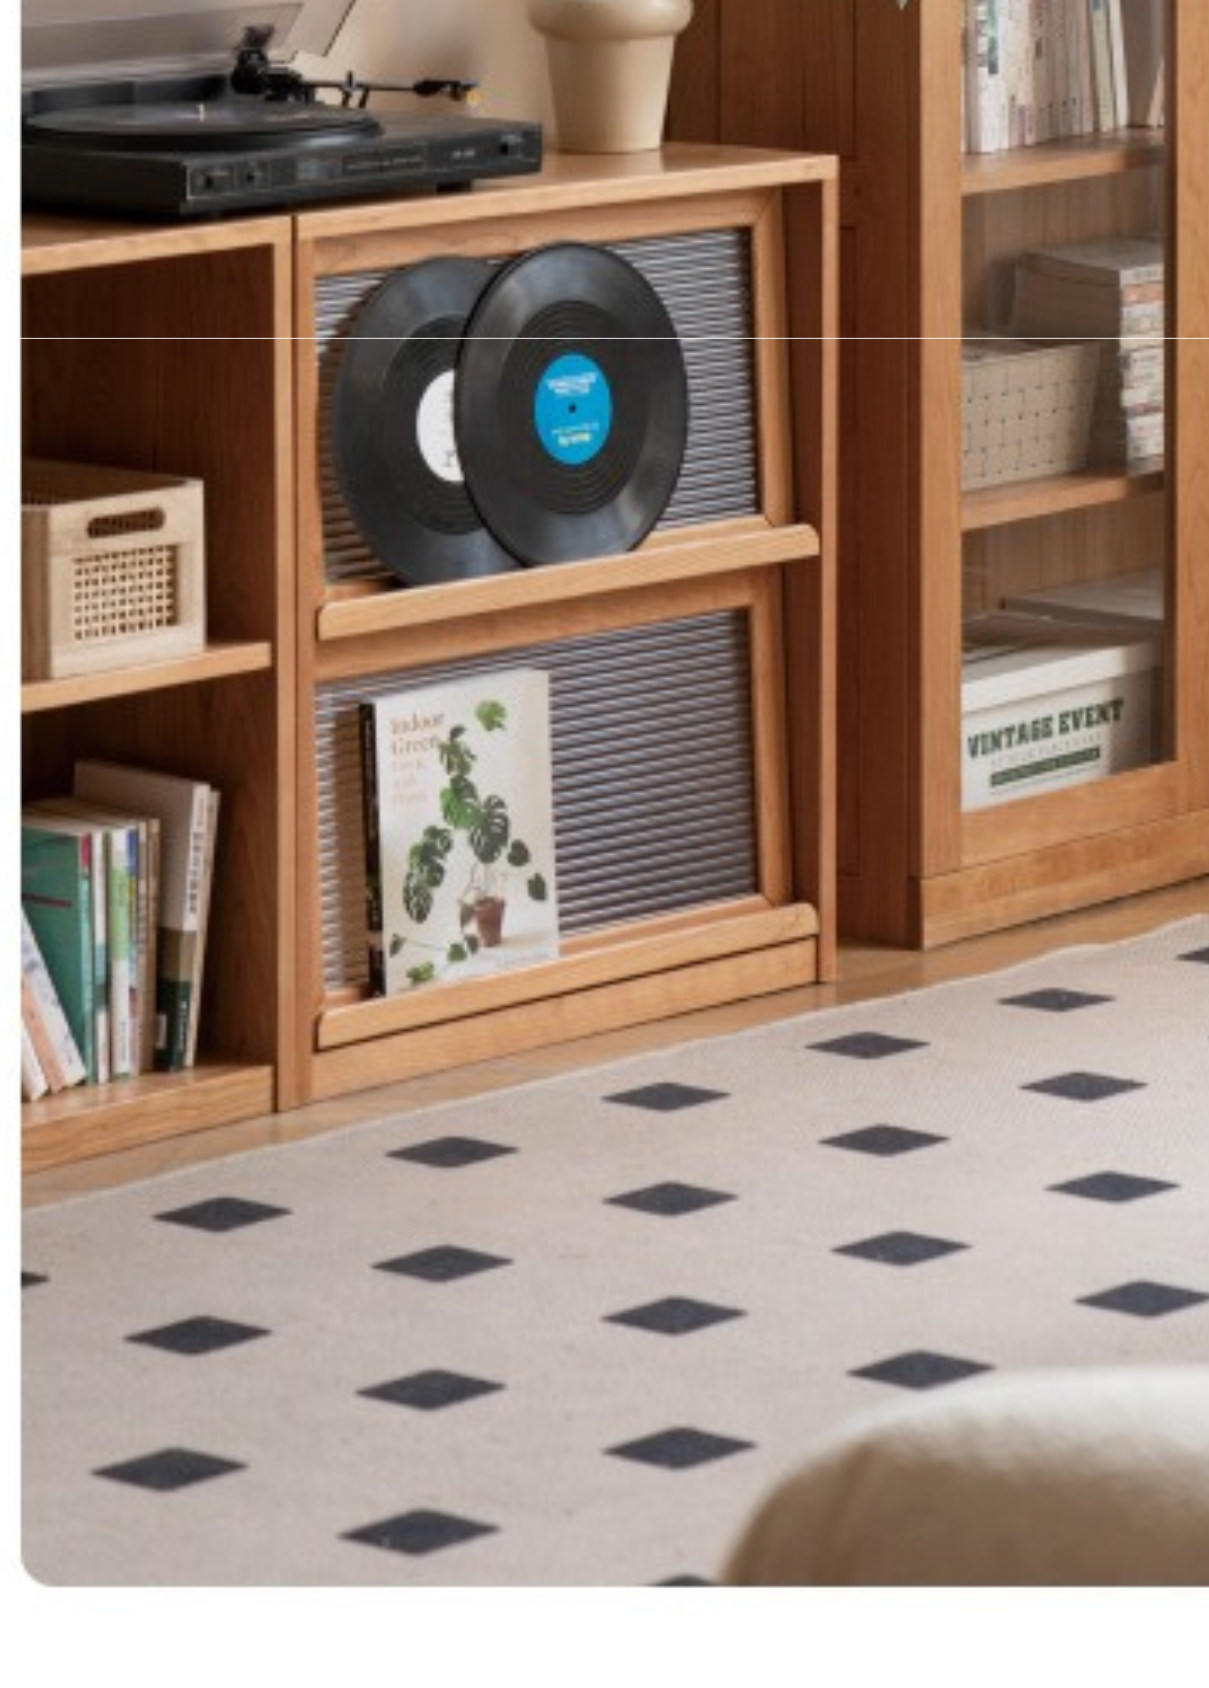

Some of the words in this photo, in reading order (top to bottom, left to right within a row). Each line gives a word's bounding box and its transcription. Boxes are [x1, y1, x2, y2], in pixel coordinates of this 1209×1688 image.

[391, 713, 444, 734] Indoor
[967, 714, 1054, 759] VINTAGE
[1058, 697, 1124, 735] EVENT
